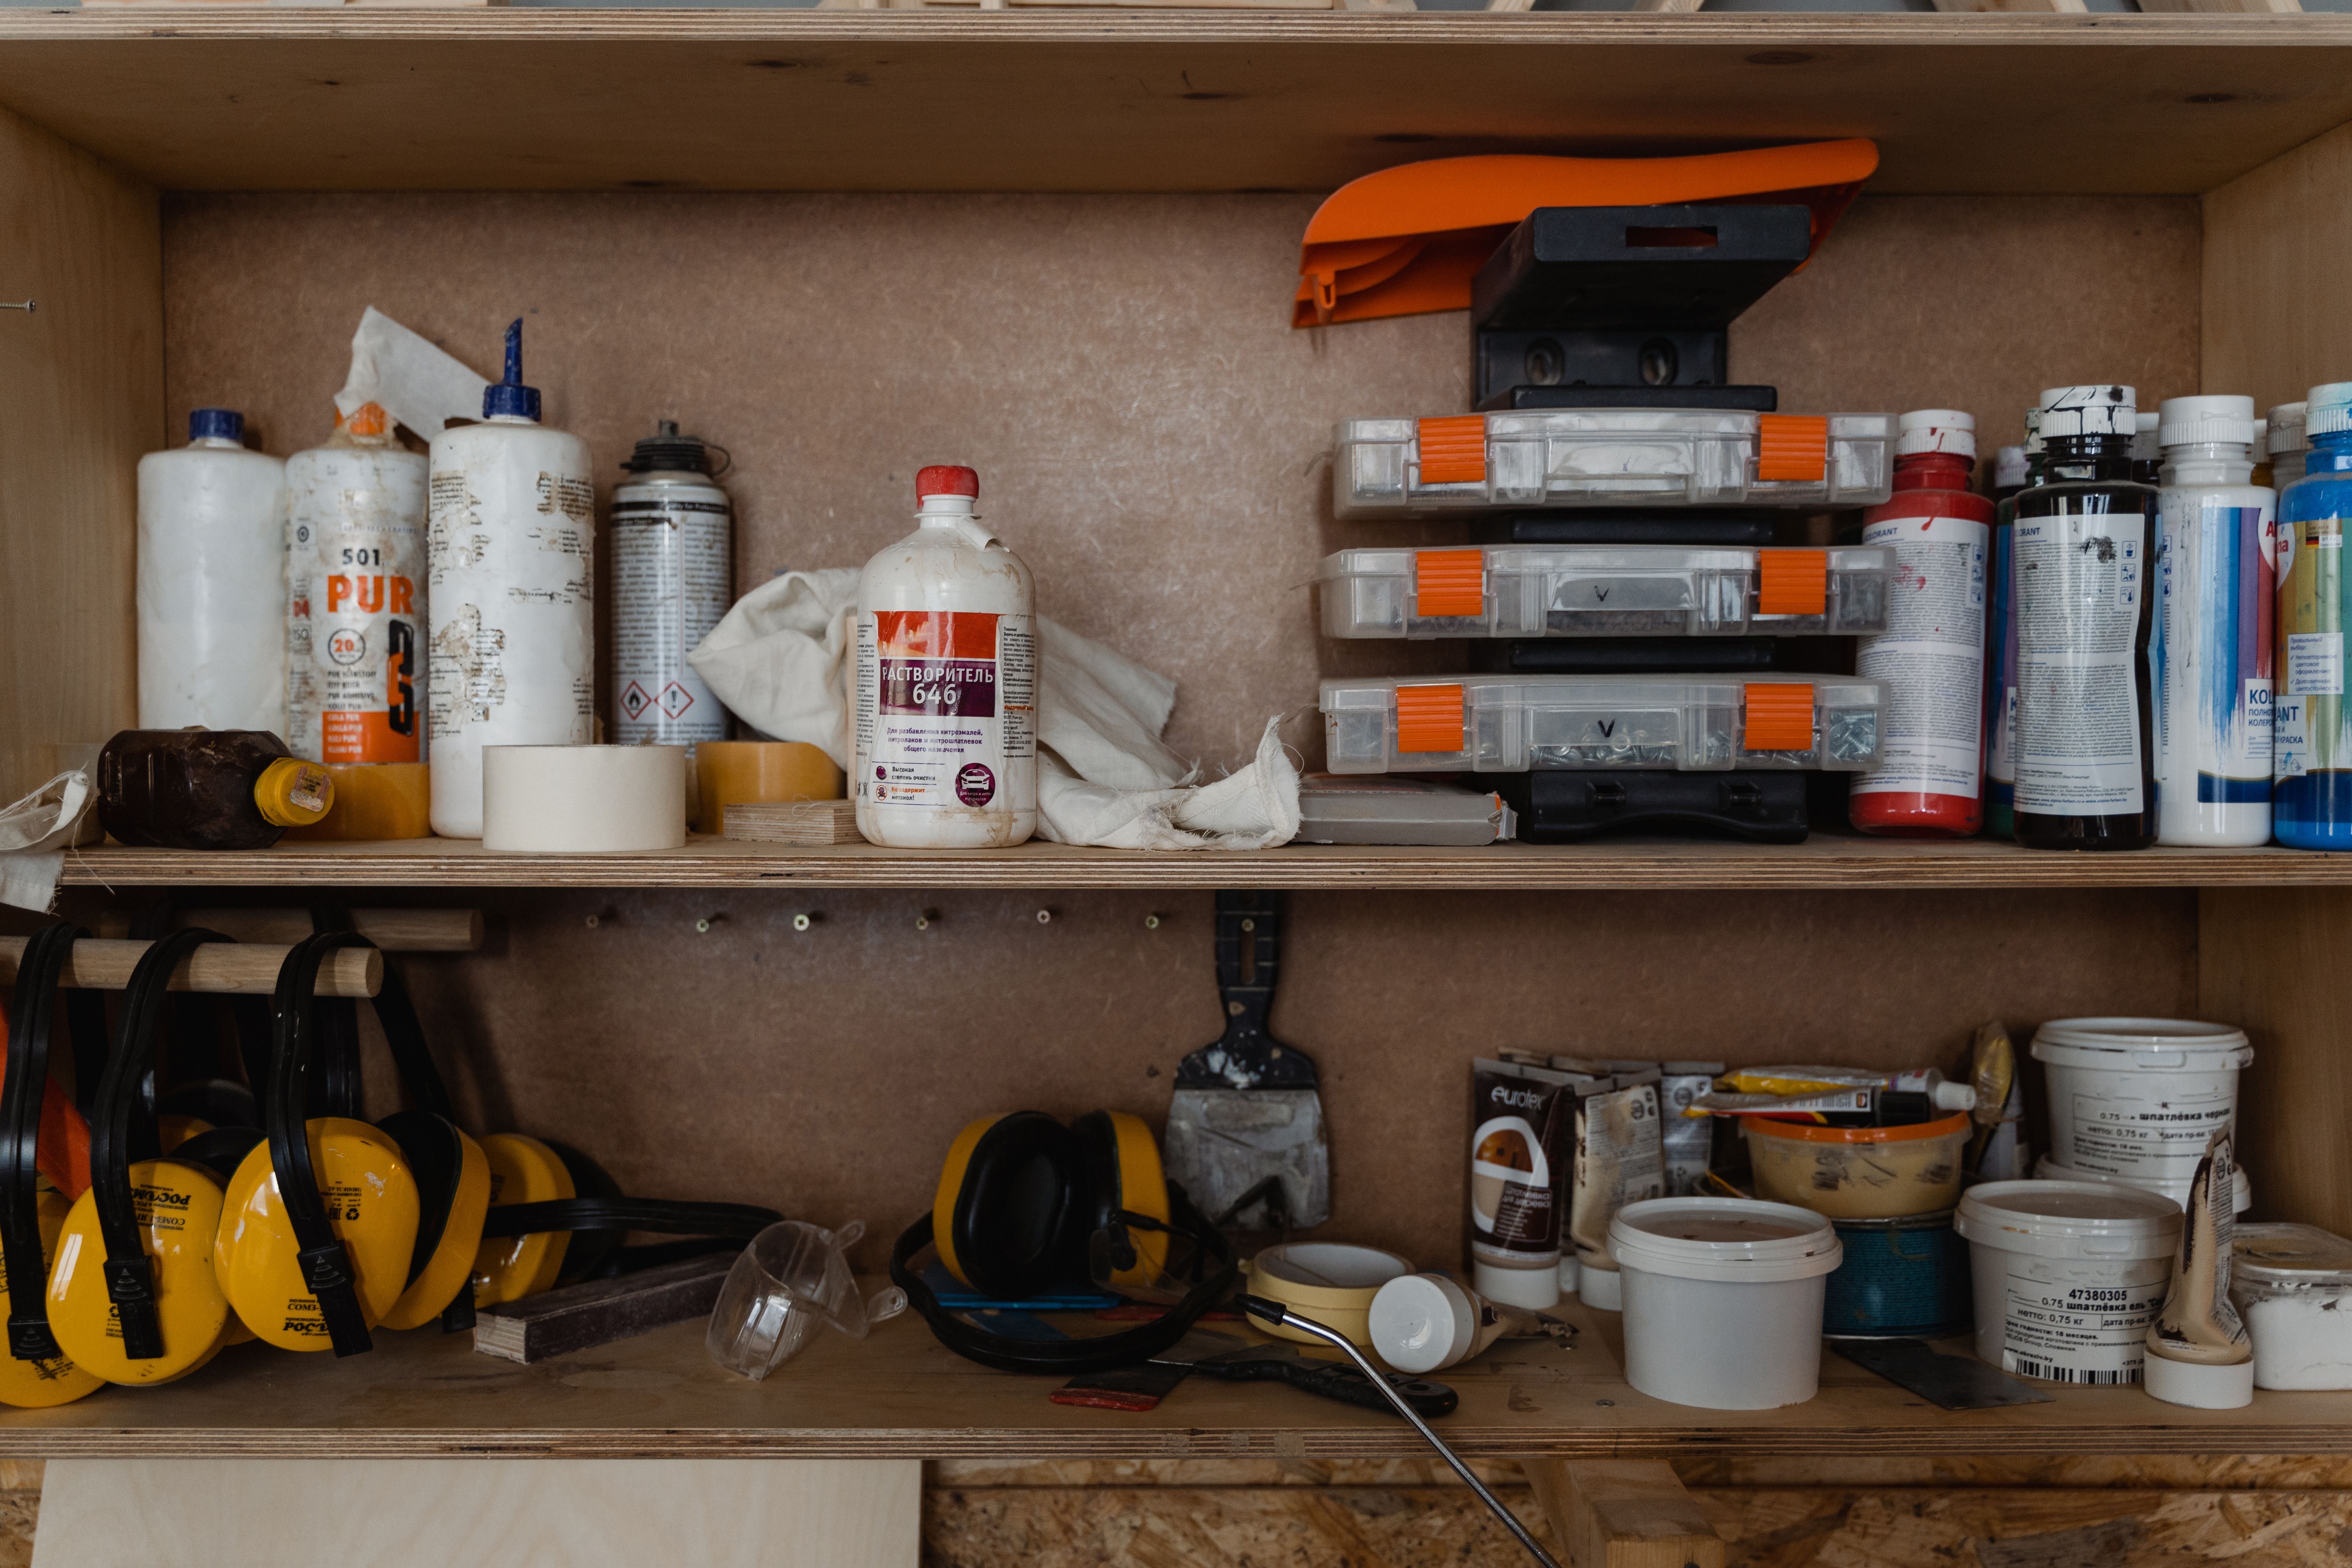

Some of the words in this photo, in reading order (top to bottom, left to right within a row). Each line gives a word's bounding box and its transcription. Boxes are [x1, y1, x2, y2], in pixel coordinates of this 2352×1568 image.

[343, 548, 380, 566] 501
[328, 575, 414, 615] PUR
[335, 639, 354, 652] 20
[883, 667, 993, 683] РАСТВОРИТЕЛЬ
[913, 683, 957, 704] 646
[2068, 1289, 2127, 1301] 47380305
[2042, 1297, 2063, 1308] 0.75
[2067, 1302, 2126, 1312] шпатлёвка
[2018, 1308, 2046, 1321] нетто:
[2049, 1314, 2071, 1324] 0,75
[2020, 1324, 2053, 1335] годности:
